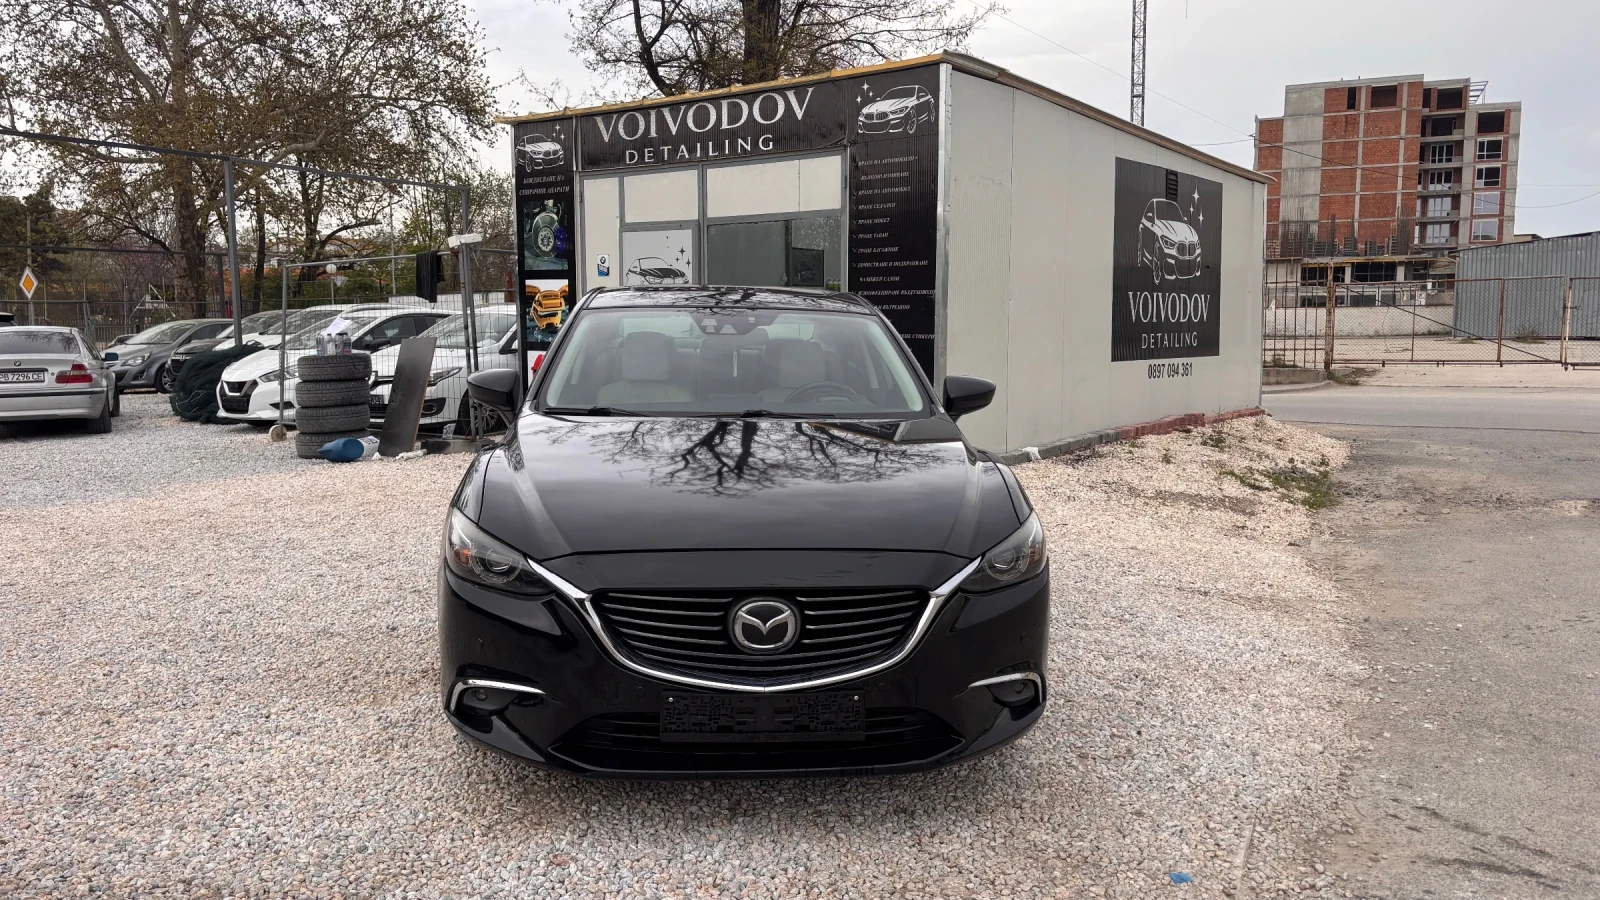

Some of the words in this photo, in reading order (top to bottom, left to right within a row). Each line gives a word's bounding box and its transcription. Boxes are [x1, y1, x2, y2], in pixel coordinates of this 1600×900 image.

[594, 87, 815, 142] VOIVODOV
[626, 135, 773, 164] DETAILING
[1128, 291, 1210, 323] VOIVODOV
[1141, 332, 1198, 349] DETAILING
[1147, 363, 1165, 379] 0897
[1167, 362, 1180, 378] 094
[1181, 361, 1193, 377] 361
